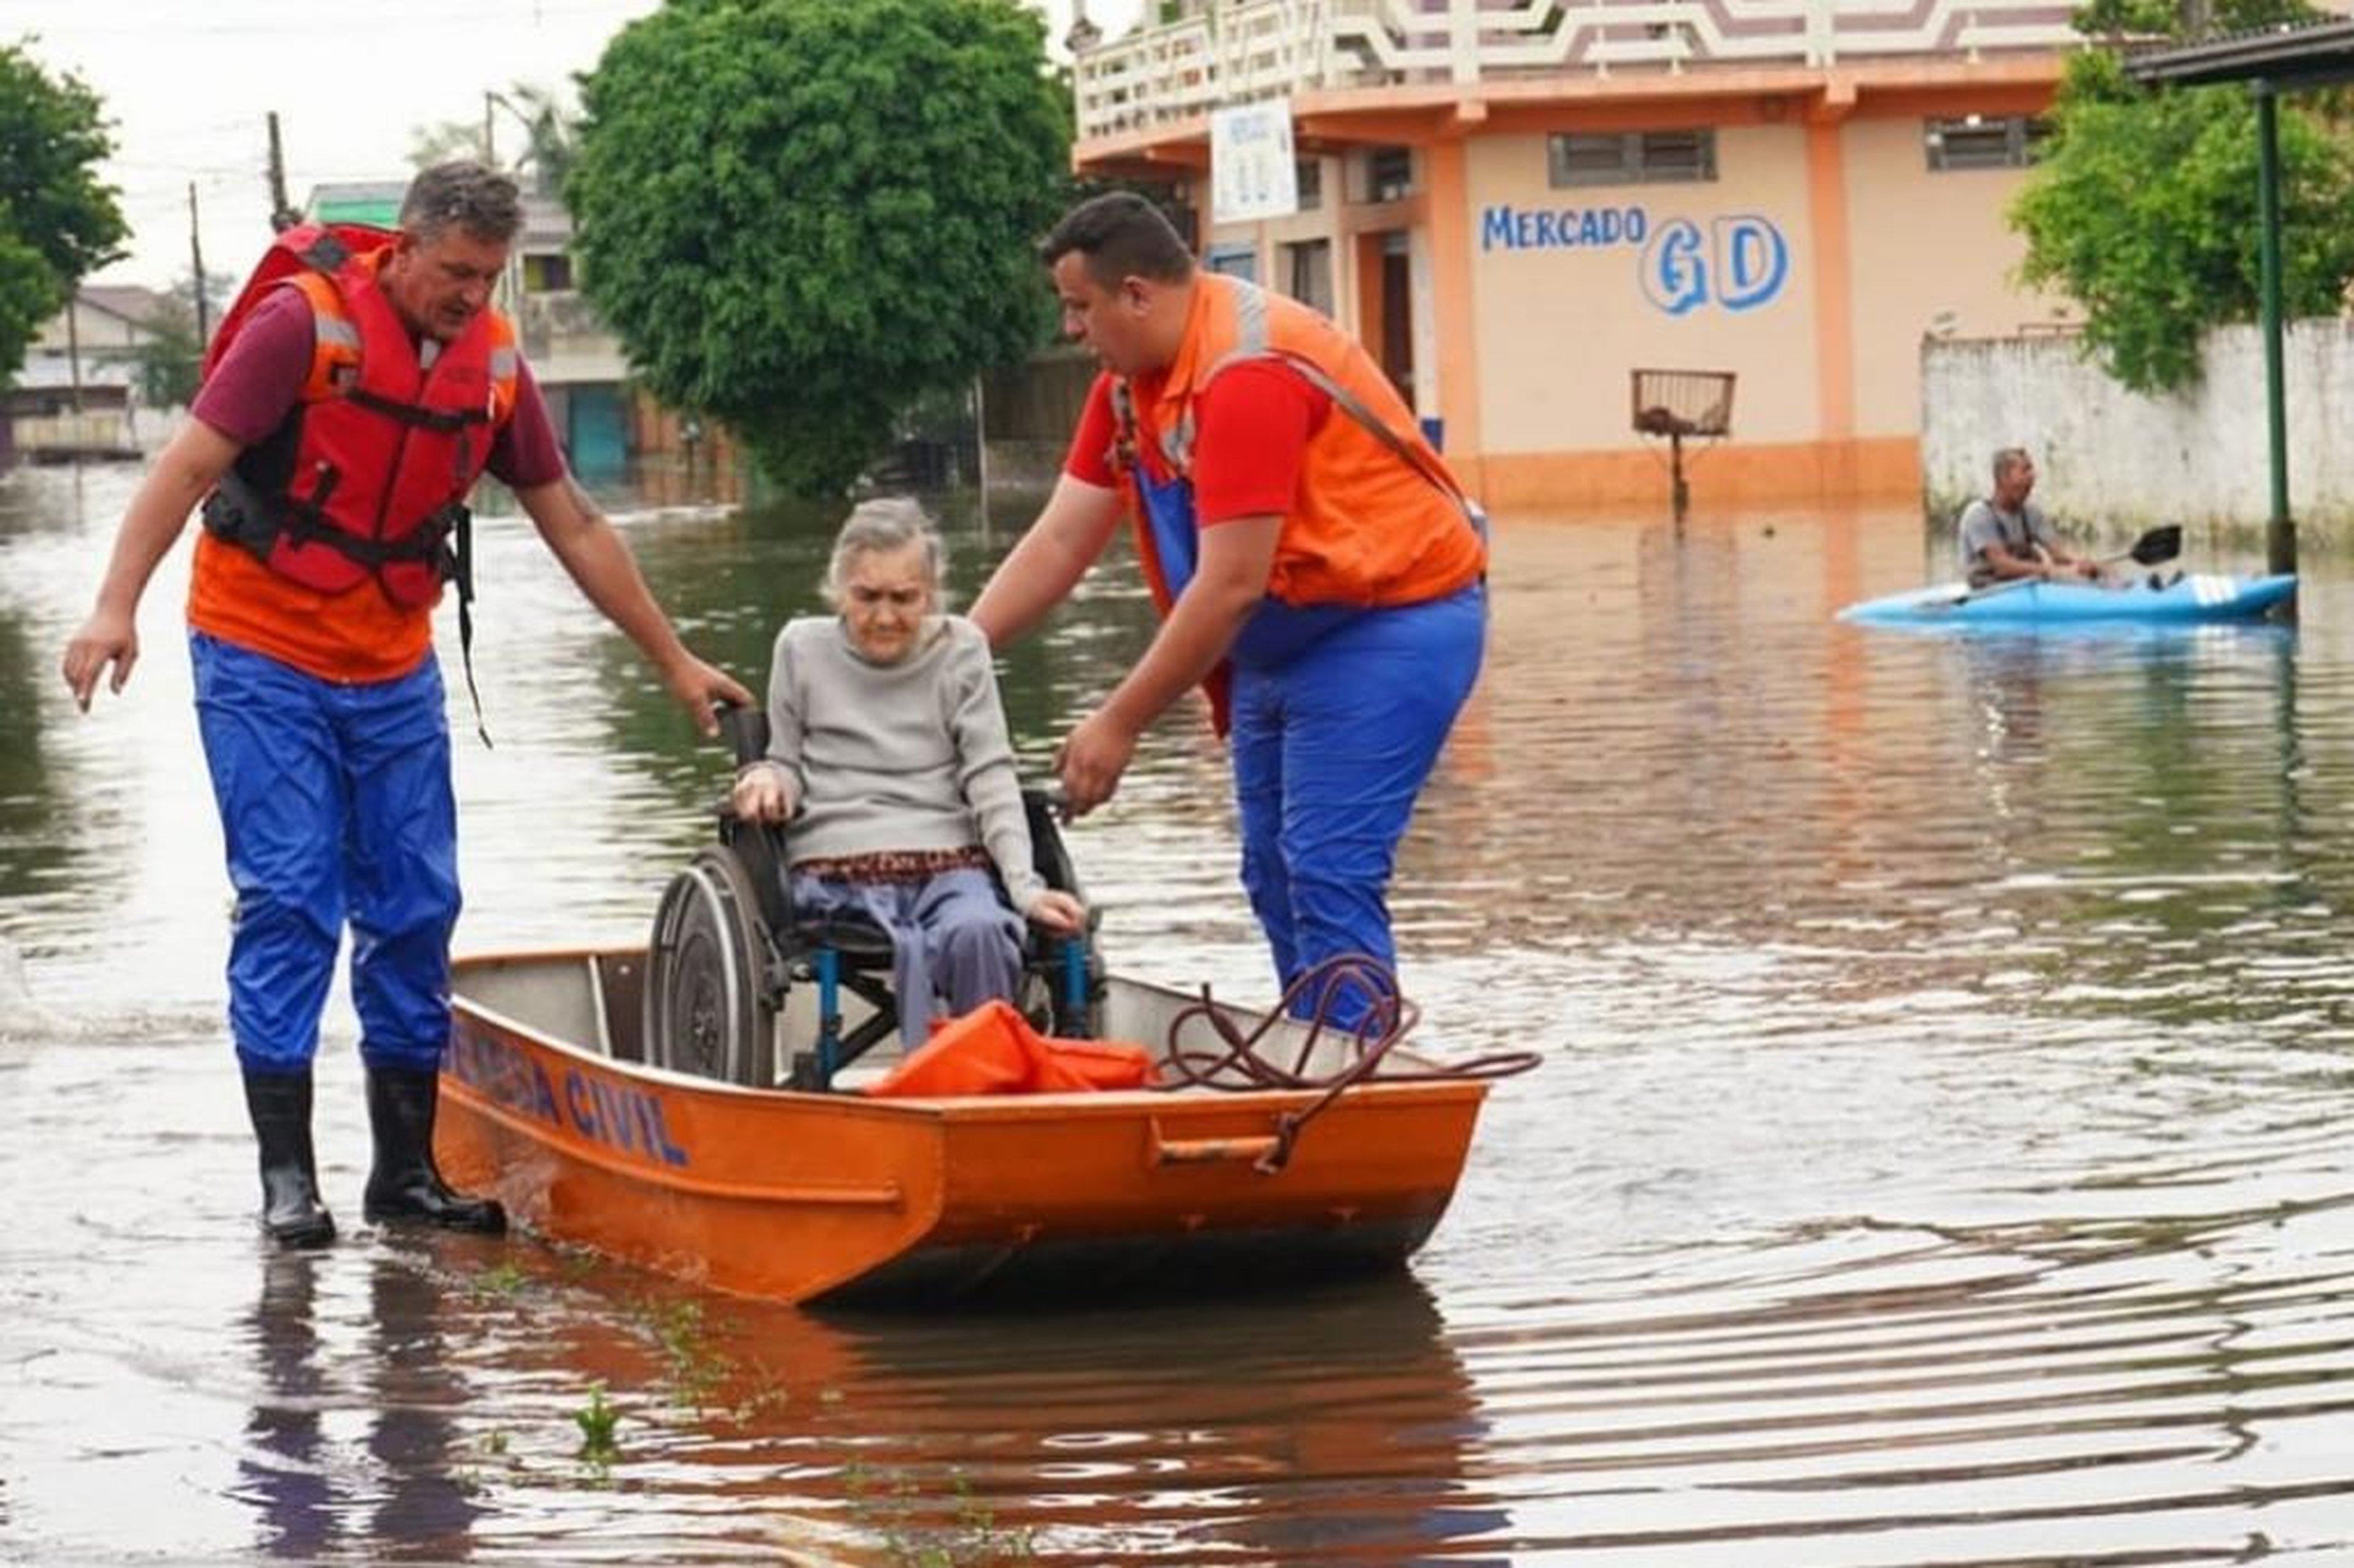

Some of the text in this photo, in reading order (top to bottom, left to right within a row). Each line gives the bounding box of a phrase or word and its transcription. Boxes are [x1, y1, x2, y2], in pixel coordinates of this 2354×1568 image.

[1482, 205, 1788, 316] MERCADO GD
[565, 1067, 687, 1166] CIVIL
